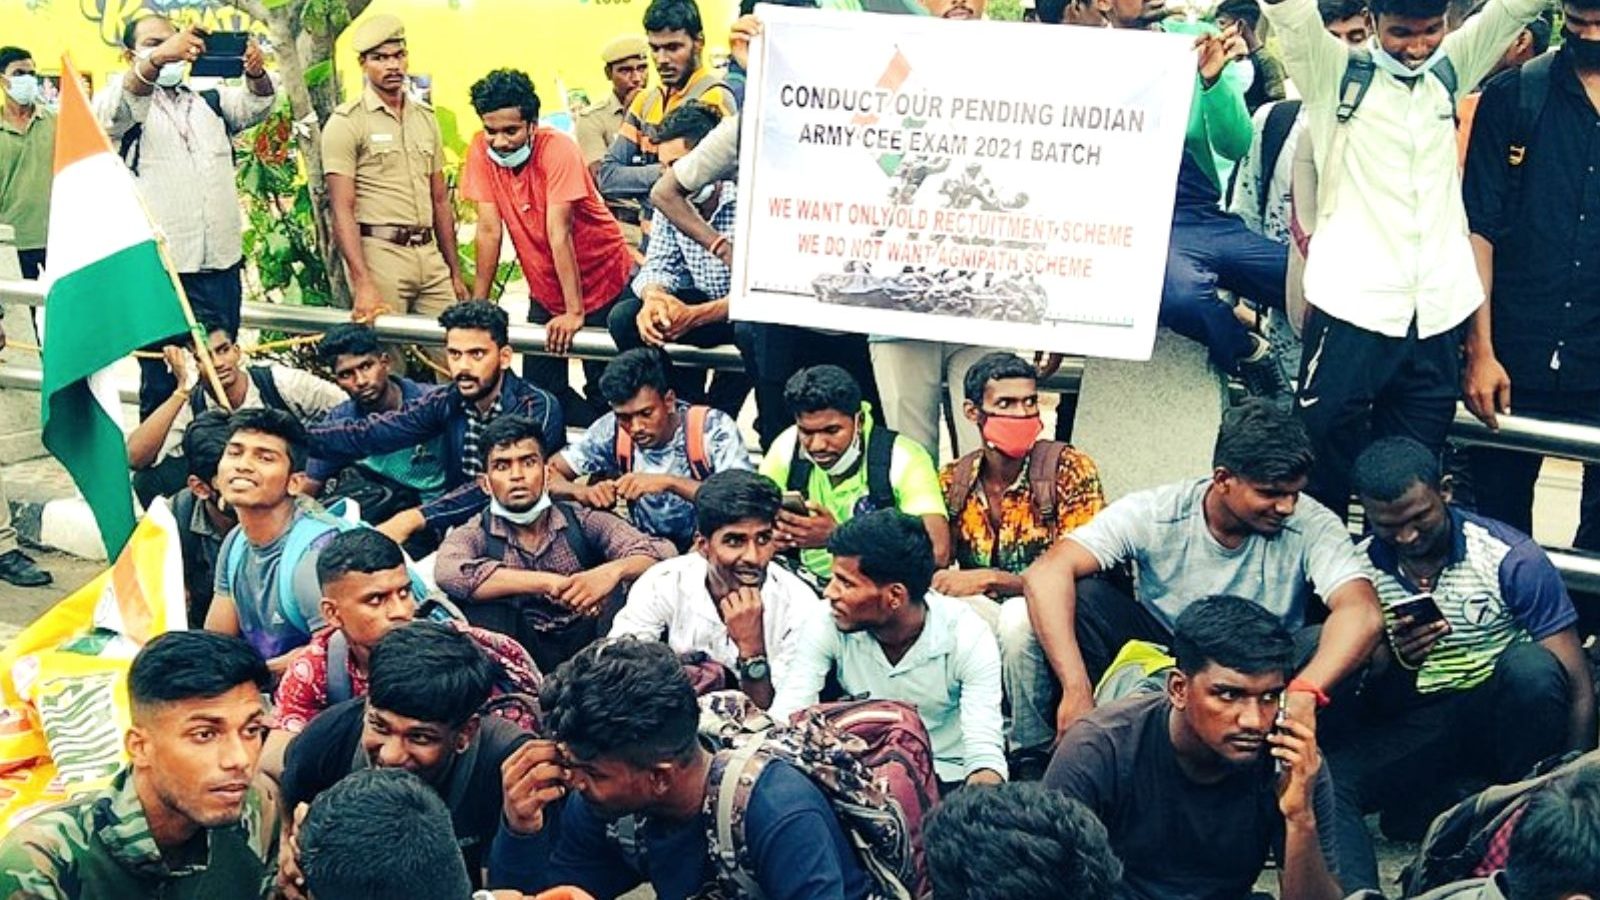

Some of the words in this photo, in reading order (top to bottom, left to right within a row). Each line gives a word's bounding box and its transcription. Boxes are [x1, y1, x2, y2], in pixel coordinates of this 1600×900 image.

[780, 84, 889, 113] CONDUCT
[895, 93, 942, 118] OUR
[950, 97, 1054, 126] PENDING
[1061, 105, 1145, 132] INDIAN
[798, 124, 855, 147] ARMY
[862, 128, 902, 150] CEE
[909, 132, 968, 155] EXAM
[974, 136, 1022, 160] 2021
[1031, 140, 1102, 166] BATCH
[768, 197, 792, 219] WE
[796, 199, 844, 222] WANT
[848, 204, 890, 227] ONLY
[896, 208, 929, 230] OLD
[1061, 221, 1135, 247] SCHEME
[798, 233, 820, 254] WE
[824, 236, 846, 256] DO
[850, 238, 883, 260] NOT
[888, 242, 933, 263] WANT
[937, 247, 1019, 271] AGNIPATH
[1025, 252, 1094, 277] SCHEME
